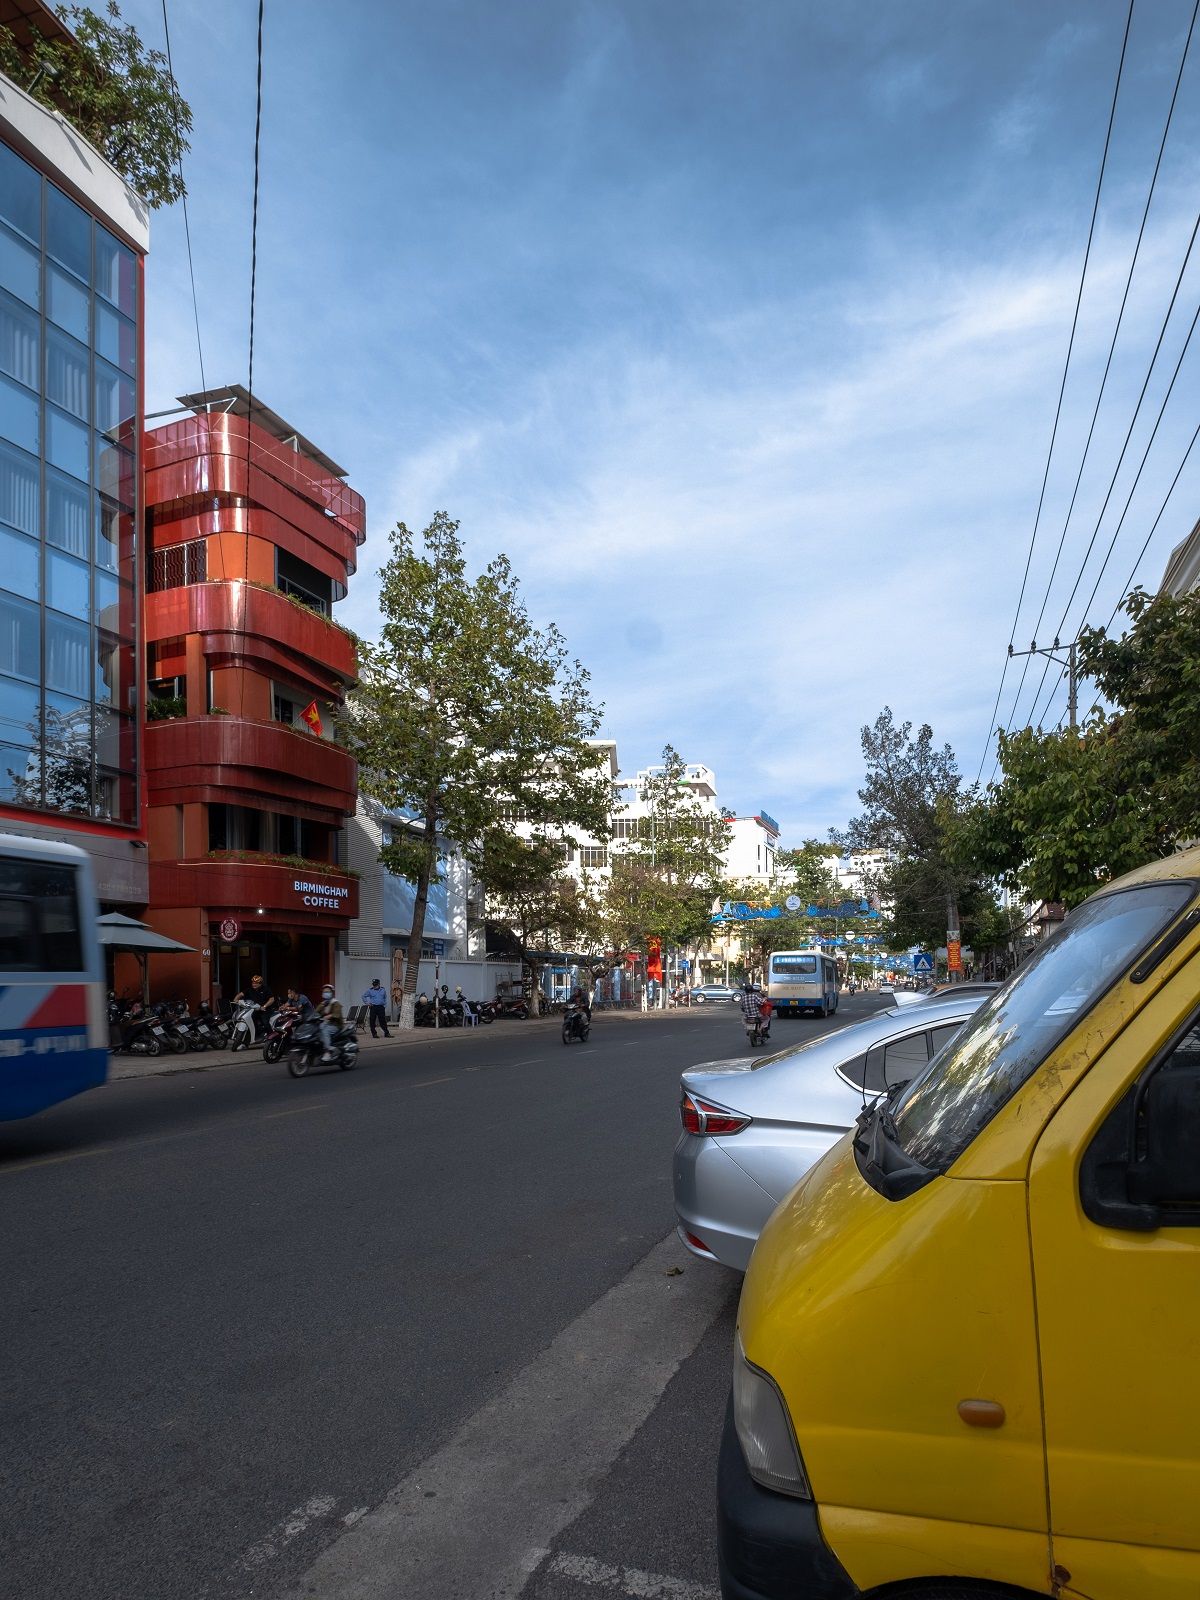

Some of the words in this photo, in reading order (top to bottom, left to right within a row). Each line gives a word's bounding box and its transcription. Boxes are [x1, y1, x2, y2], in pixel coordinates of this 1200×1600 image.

[294, 880, 348, 898] BIRMINGHAM
[303, 895, 340, 909] COFFEE
[202, 948, 211, 956] 60
